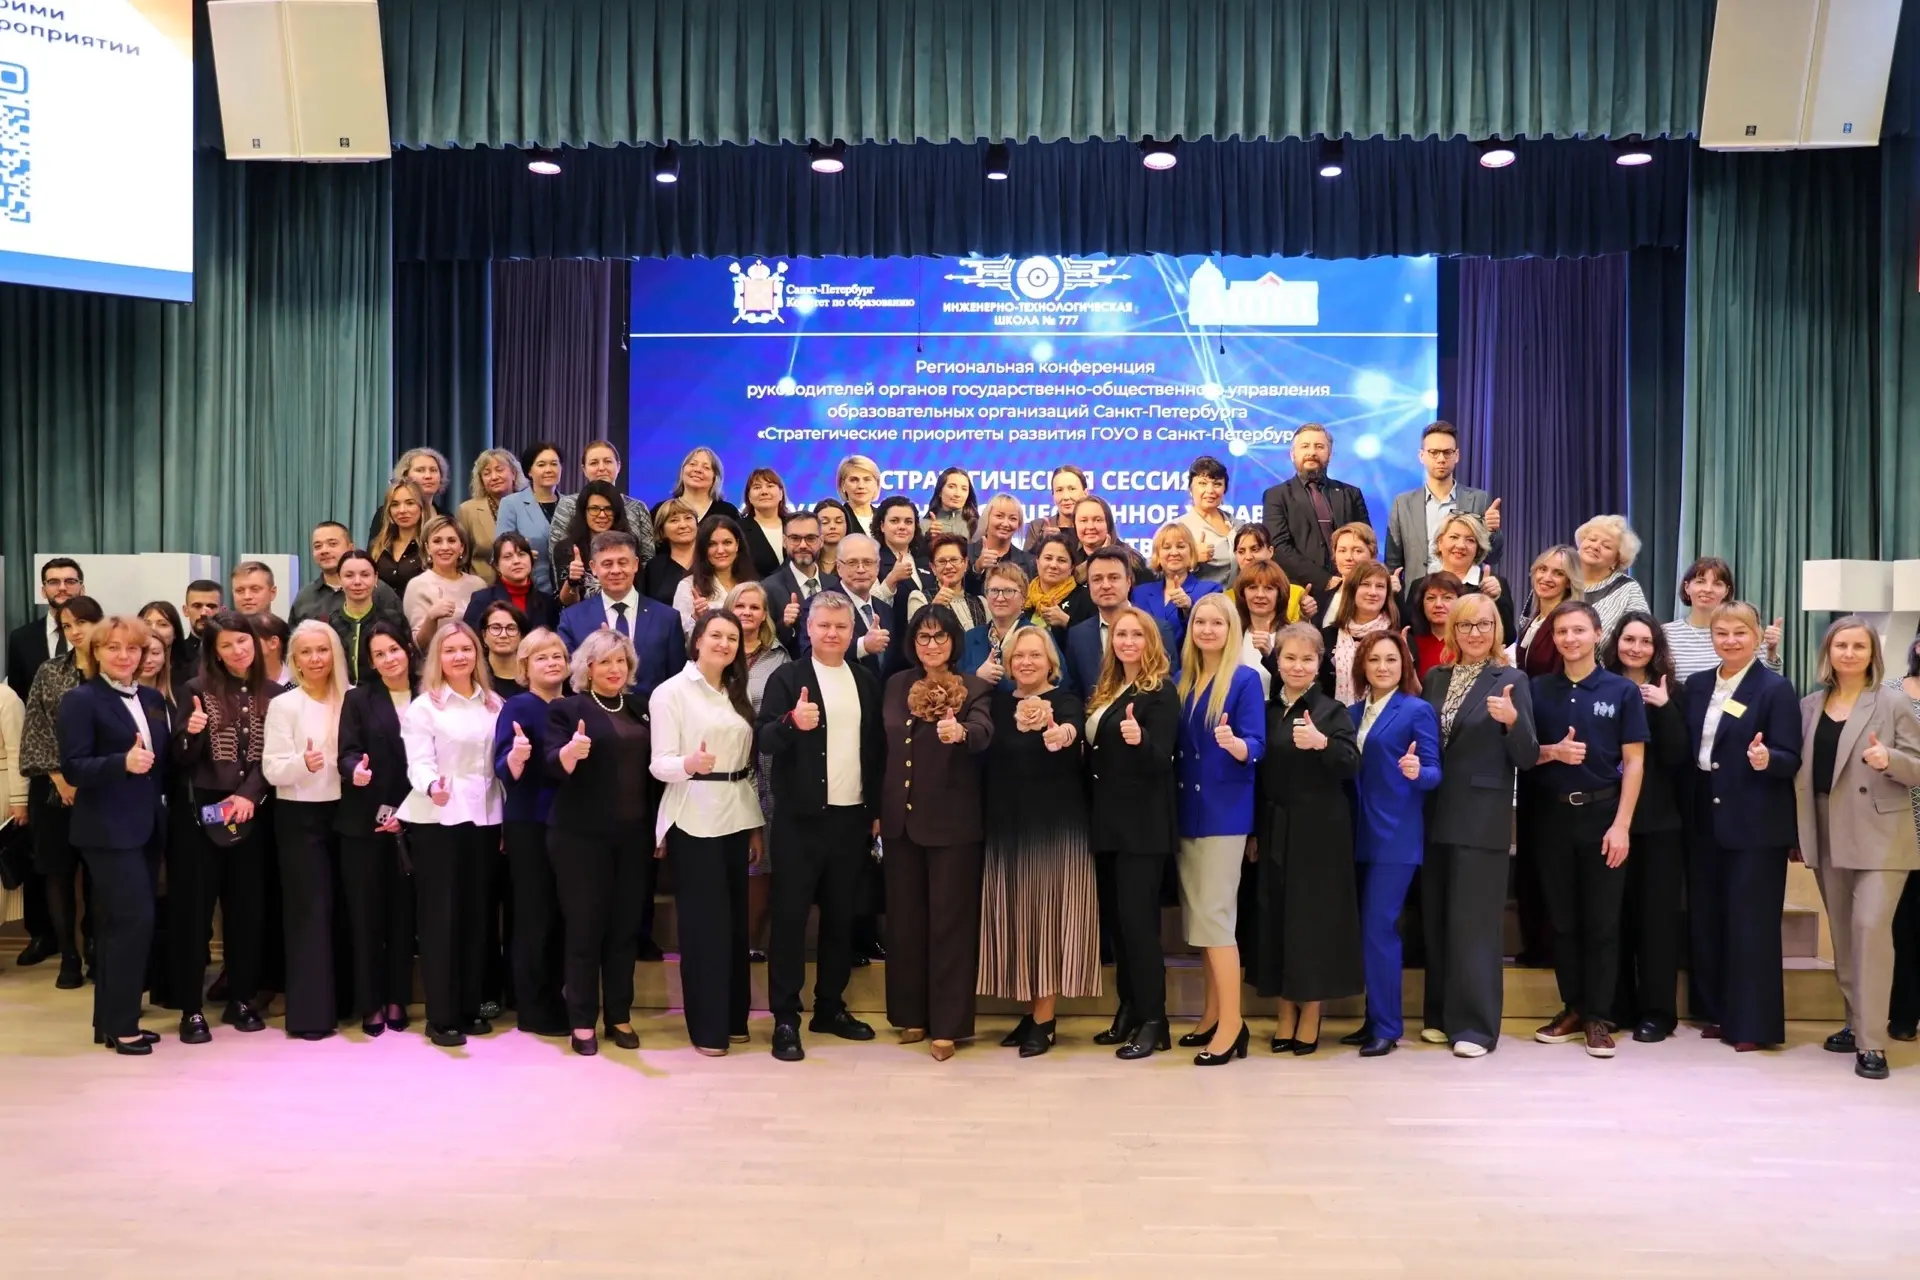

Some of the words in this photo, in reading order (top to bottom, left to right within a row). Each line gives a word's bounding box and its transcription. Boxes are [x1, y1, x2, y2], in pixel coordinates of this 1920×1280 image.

[786, 284, 875, 297] Санкт-Петербург
[832, 299, 845, 307] по
[847, 297, 915, 310] образованию
[943, 302, 1133, 313] ИНЖЕНЕРНО-ТЕХНОЛОГИЧЕСКАЯ
[994, 315, 1039, 326] ШКОЛА
[1042, 315, 1056, 326] №
[1059, 315, 1079, 326] 777
[916, 360, 1034, 374] Региональная
[1039, 359, 1155, 376] конференция
[747, 382, 875, 398] рукоодителей
[879, 386, 947, 398] органов
[1228, 386, 1330, 399] управления
[827, 404, 974, 420] образовательных
[978, 404, 1088, 420] организаций
[1093, 404, 1248, 421] Санкт-Петербурга
[757, 427, 898, 442] «Стратегические
[902, 430, 1003, 443] приоритеты
[1009, 430, 1086, 443] развития
[1091, 427, 1139, 441] ГОУО
[1143, 430, 1152, 441] в
[1156, 426, 1298, 443] Санкт-Петербур
